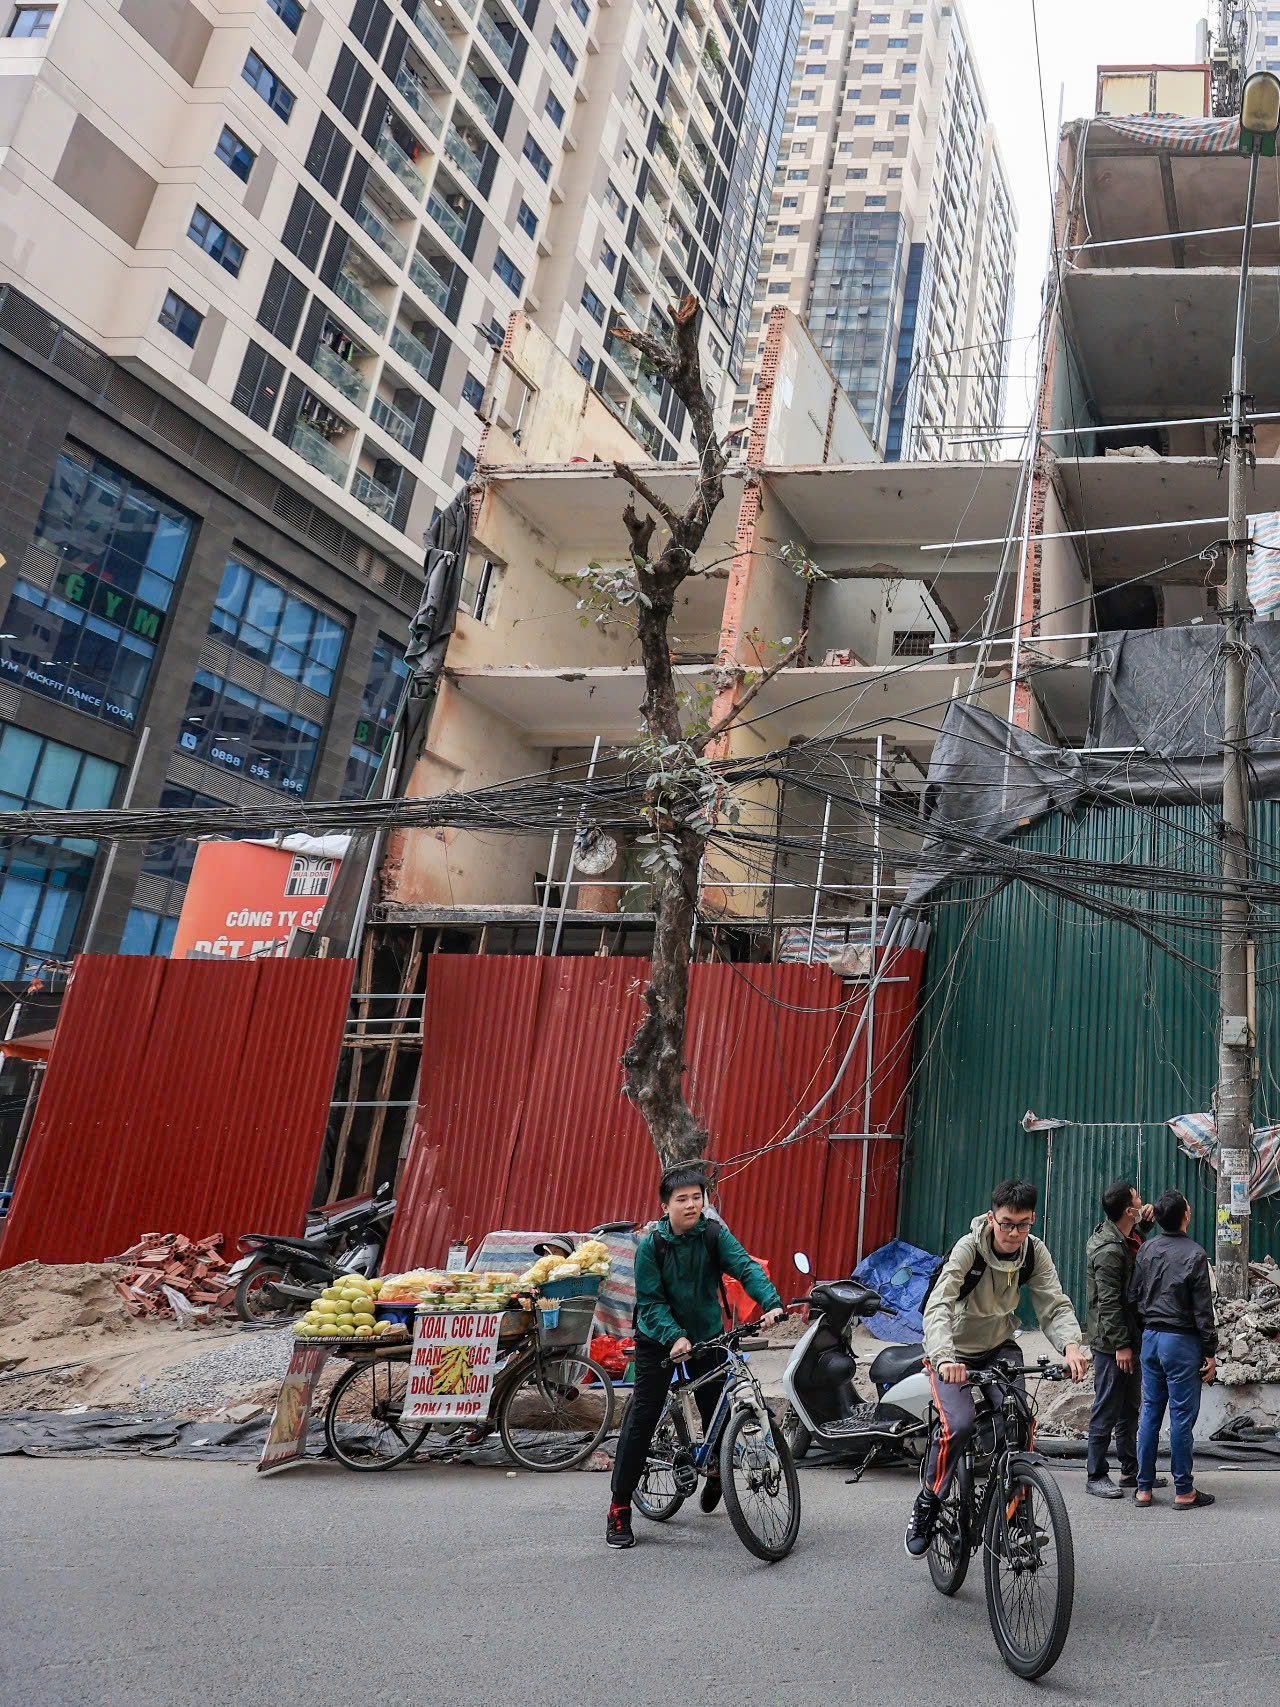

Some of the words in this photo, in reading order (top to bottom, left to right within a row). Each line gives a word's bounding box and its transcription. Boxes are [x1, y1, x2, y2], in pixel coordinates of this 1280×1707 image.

[64, 573, 159, 639] GYM
[0, 658, 18, 673] YM
[26, 670, 64, 691] KICKFIT
[66, 687, 101, 706] DANCE
[106, 702, 134, 720] YOGA
[211, 747, 241, 767] 0888
[250, 764, 270, 779] 595
[282, 777, 303, 792] 896
[226, 908, 273, 927] CÔNG
[278, 911, 298, 927] TY
